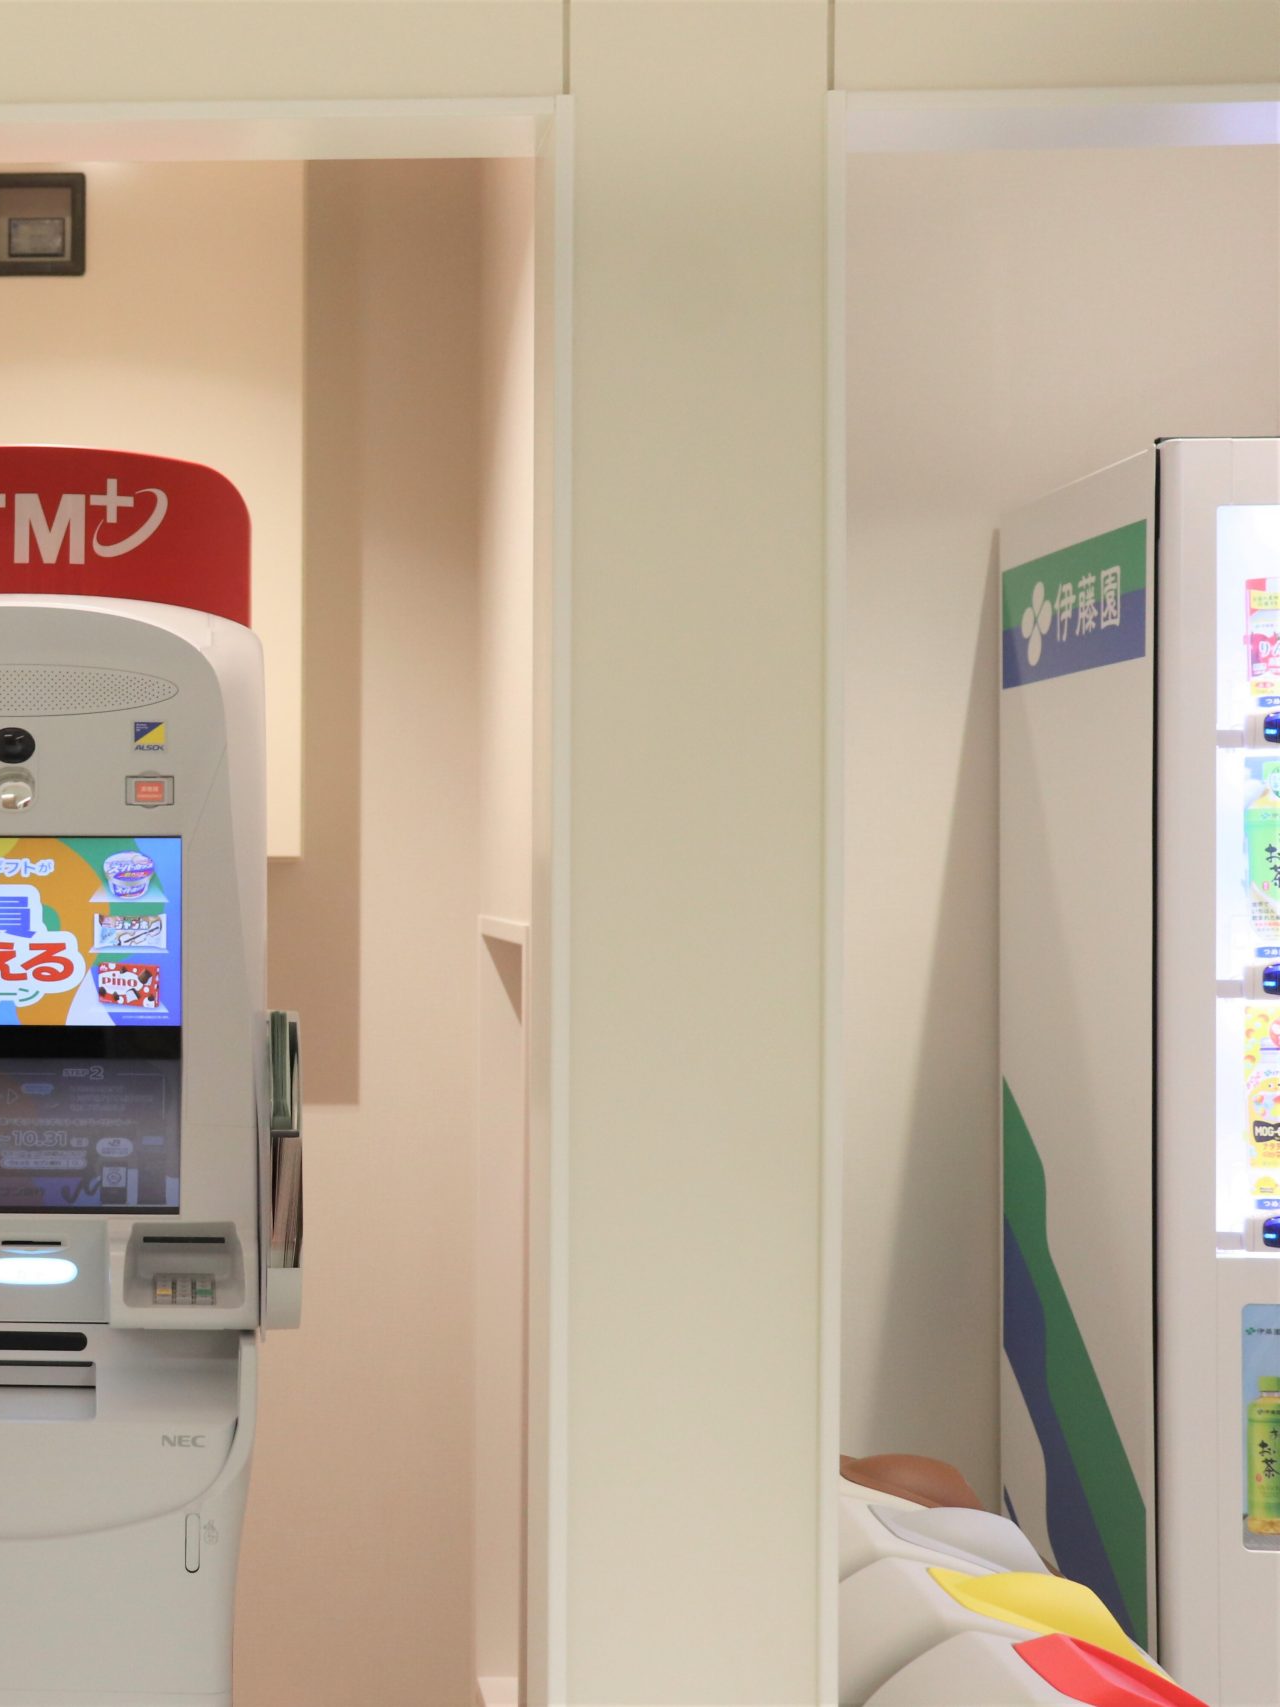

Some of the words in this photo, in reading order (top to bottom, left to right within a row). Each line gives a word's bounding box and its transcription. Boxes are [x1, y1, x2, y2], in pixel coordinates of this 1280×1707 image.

[1054, 565, 1121, 642] 伊藤園
[101, 973, 138, 987] pino
[161, 1434, 206, 1448] NEC
